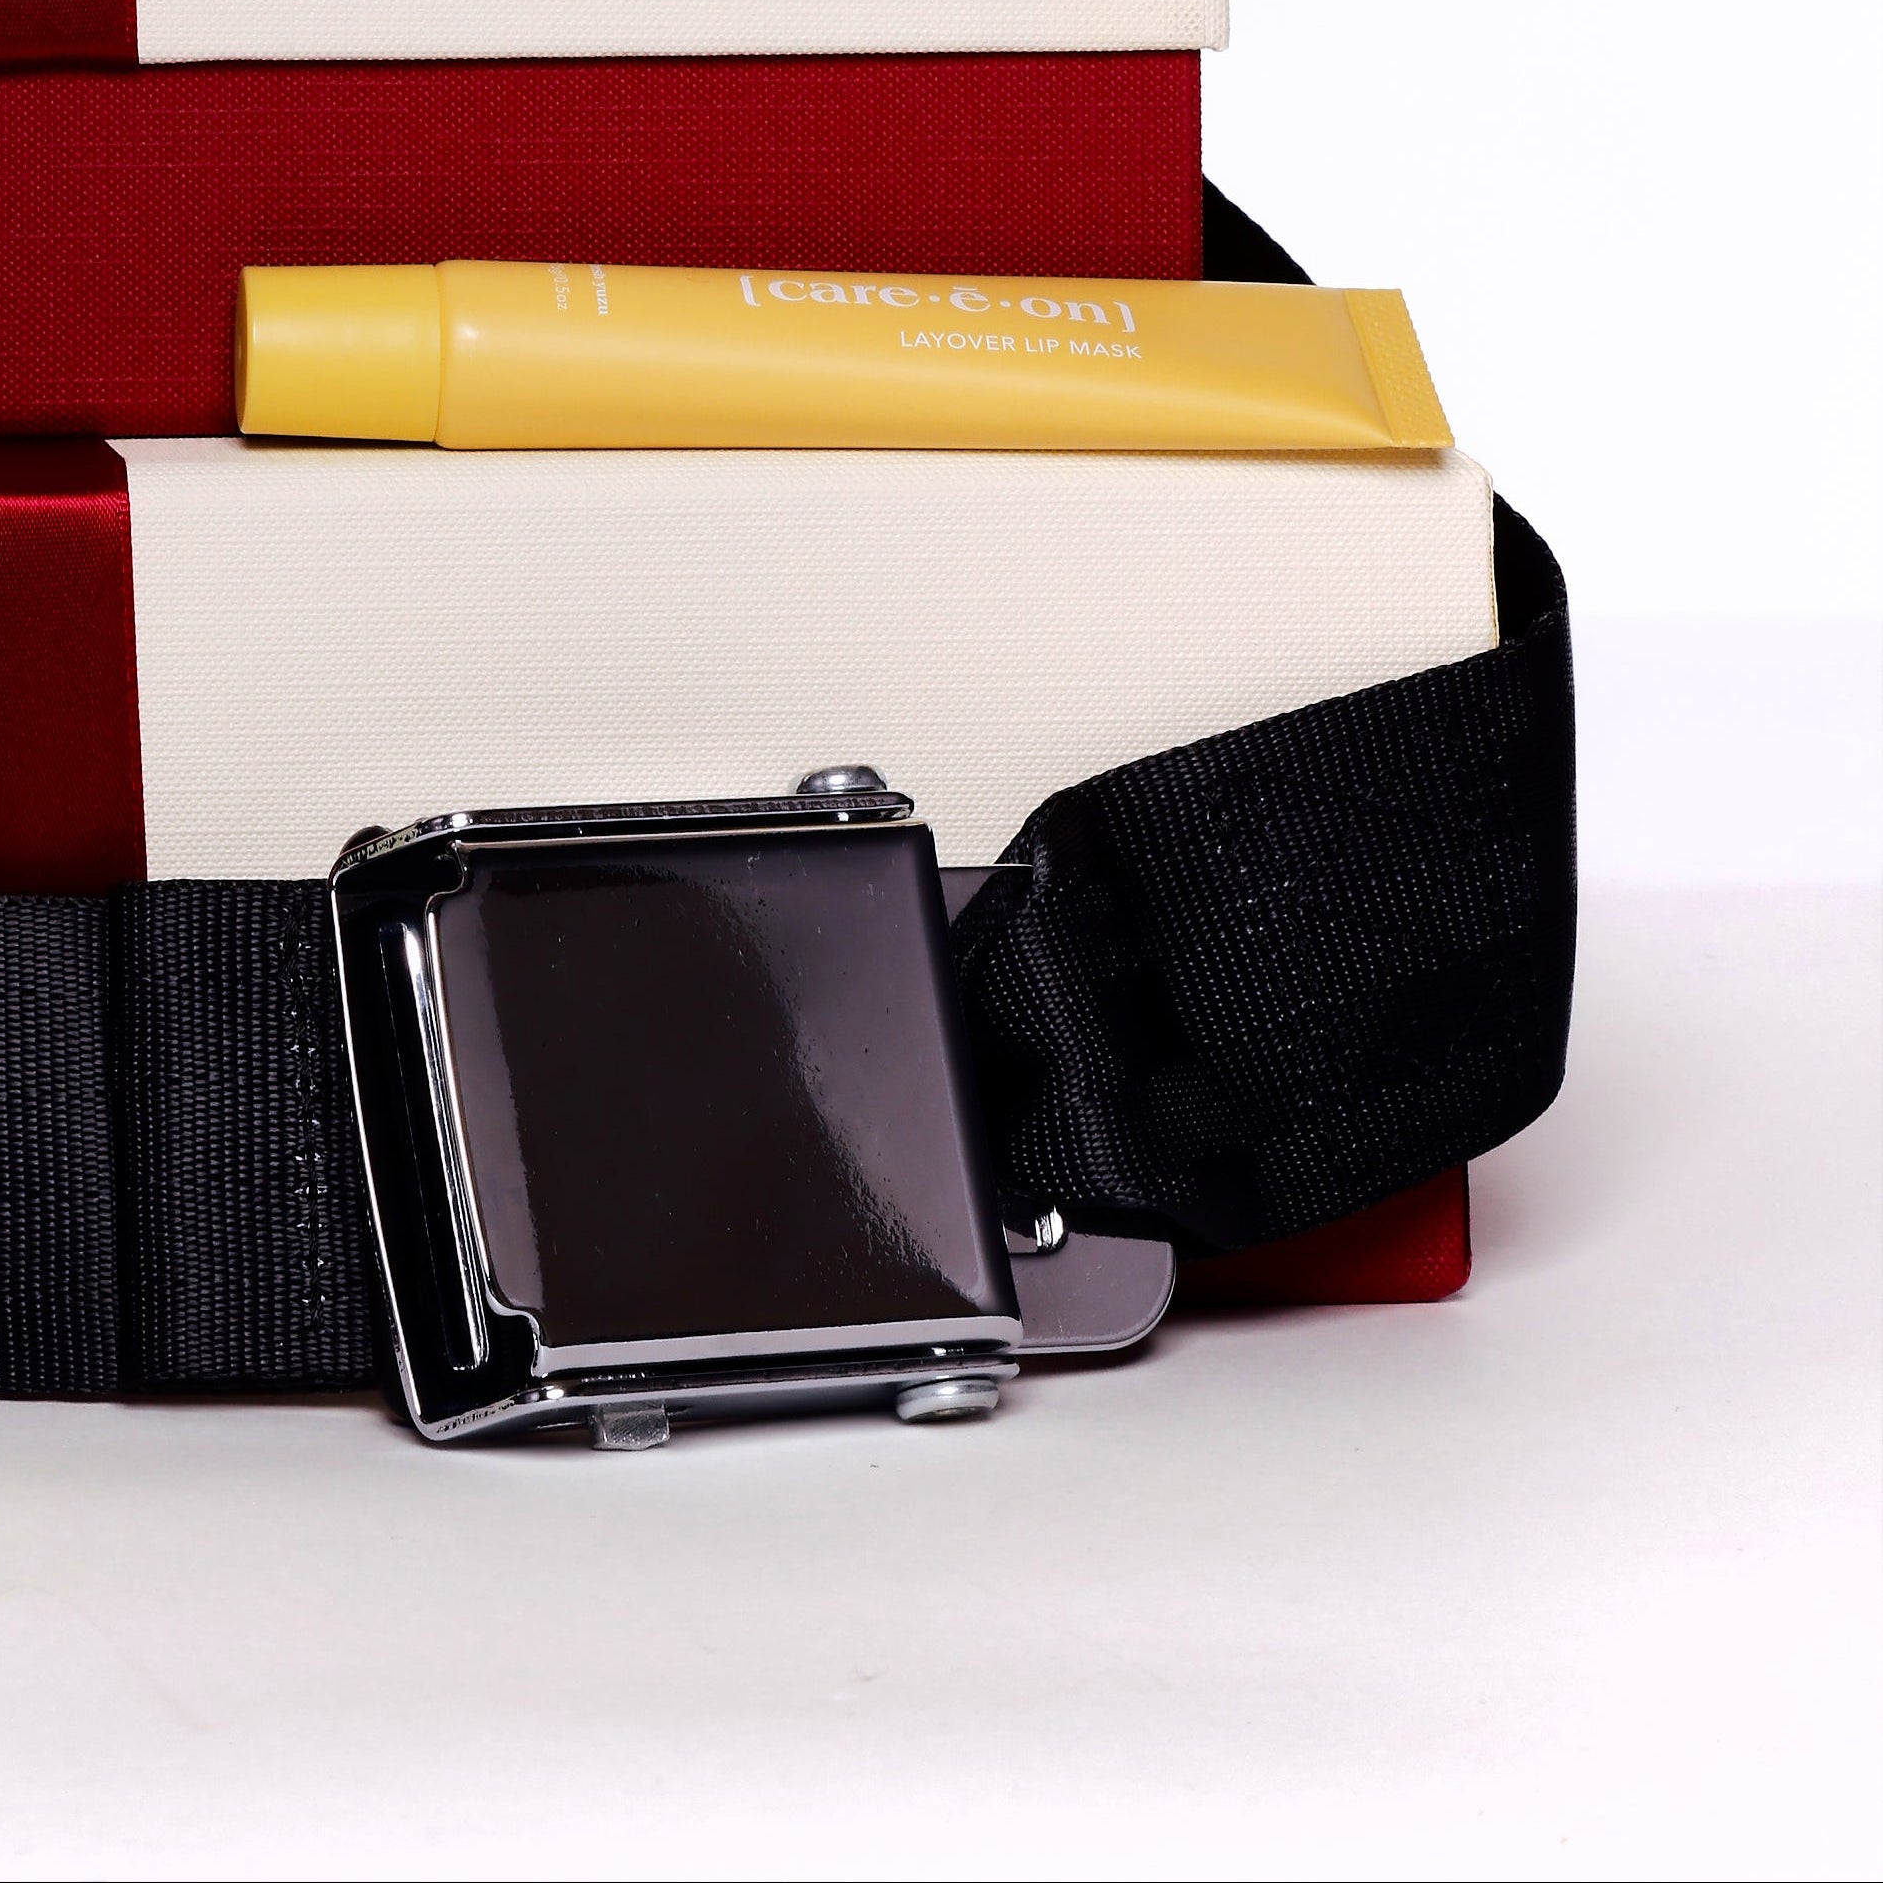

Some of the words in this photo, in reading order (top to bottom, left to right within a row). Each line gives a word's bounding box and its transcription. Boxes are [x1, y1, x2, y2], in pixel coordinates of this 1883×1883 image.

[592, 280, 608, 315] yuzu
[900, 331, 1016, 352] LAYOVER
[1024, 337, 1060, 354] LIP
[1069, 341, 1142, 360] MASK
